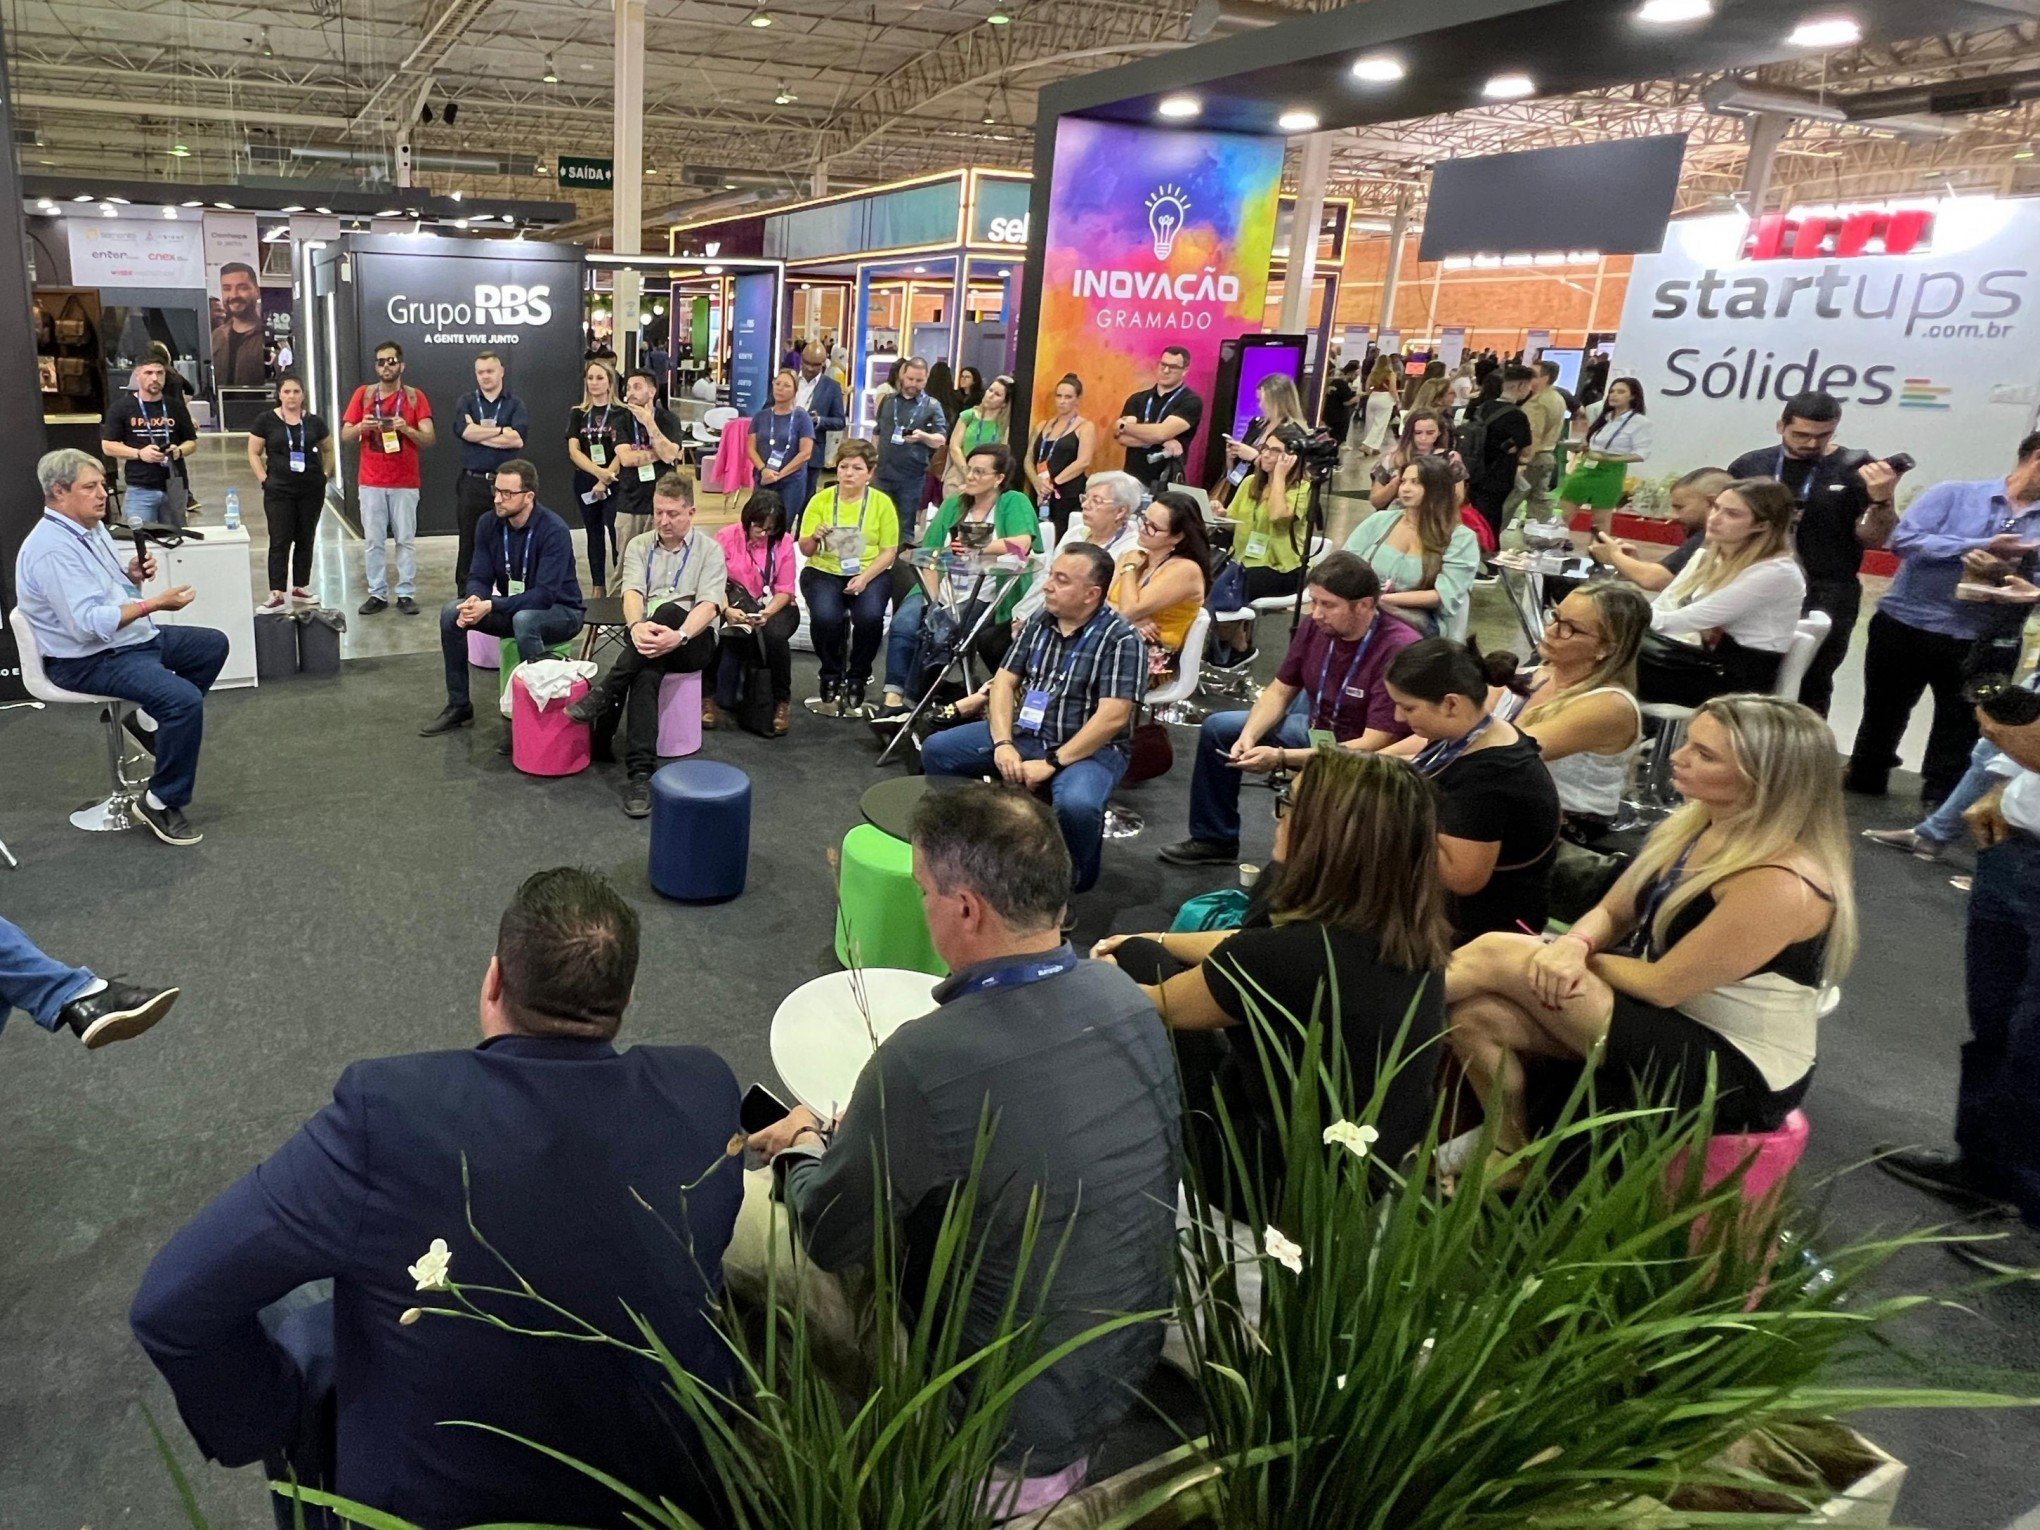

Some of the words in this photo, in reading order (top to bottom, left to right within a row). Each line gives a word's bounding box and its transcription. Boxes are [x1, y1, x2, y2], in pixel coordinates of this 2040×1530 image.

[568, 165, 604, 181] SAÍDA
[1072, 266, 1240, 306] INOVAÇÃO
[1651, 264, 2028, 337] startups
[387, 294, 471, 331] Grupo
[475, 284, 552, 326] RBS
[1096, 309, 1212, 330] GRAMADO
[424, 333, 433, 344] A
[434, 334, 465, 344] GENTE
[465, 334, 487, 344] VIVE
[488, 334, 519, 344] JUNTO
[1921, 321, 2014, 339] .com.br
[1660, 346, 1896, 406] Sólides
